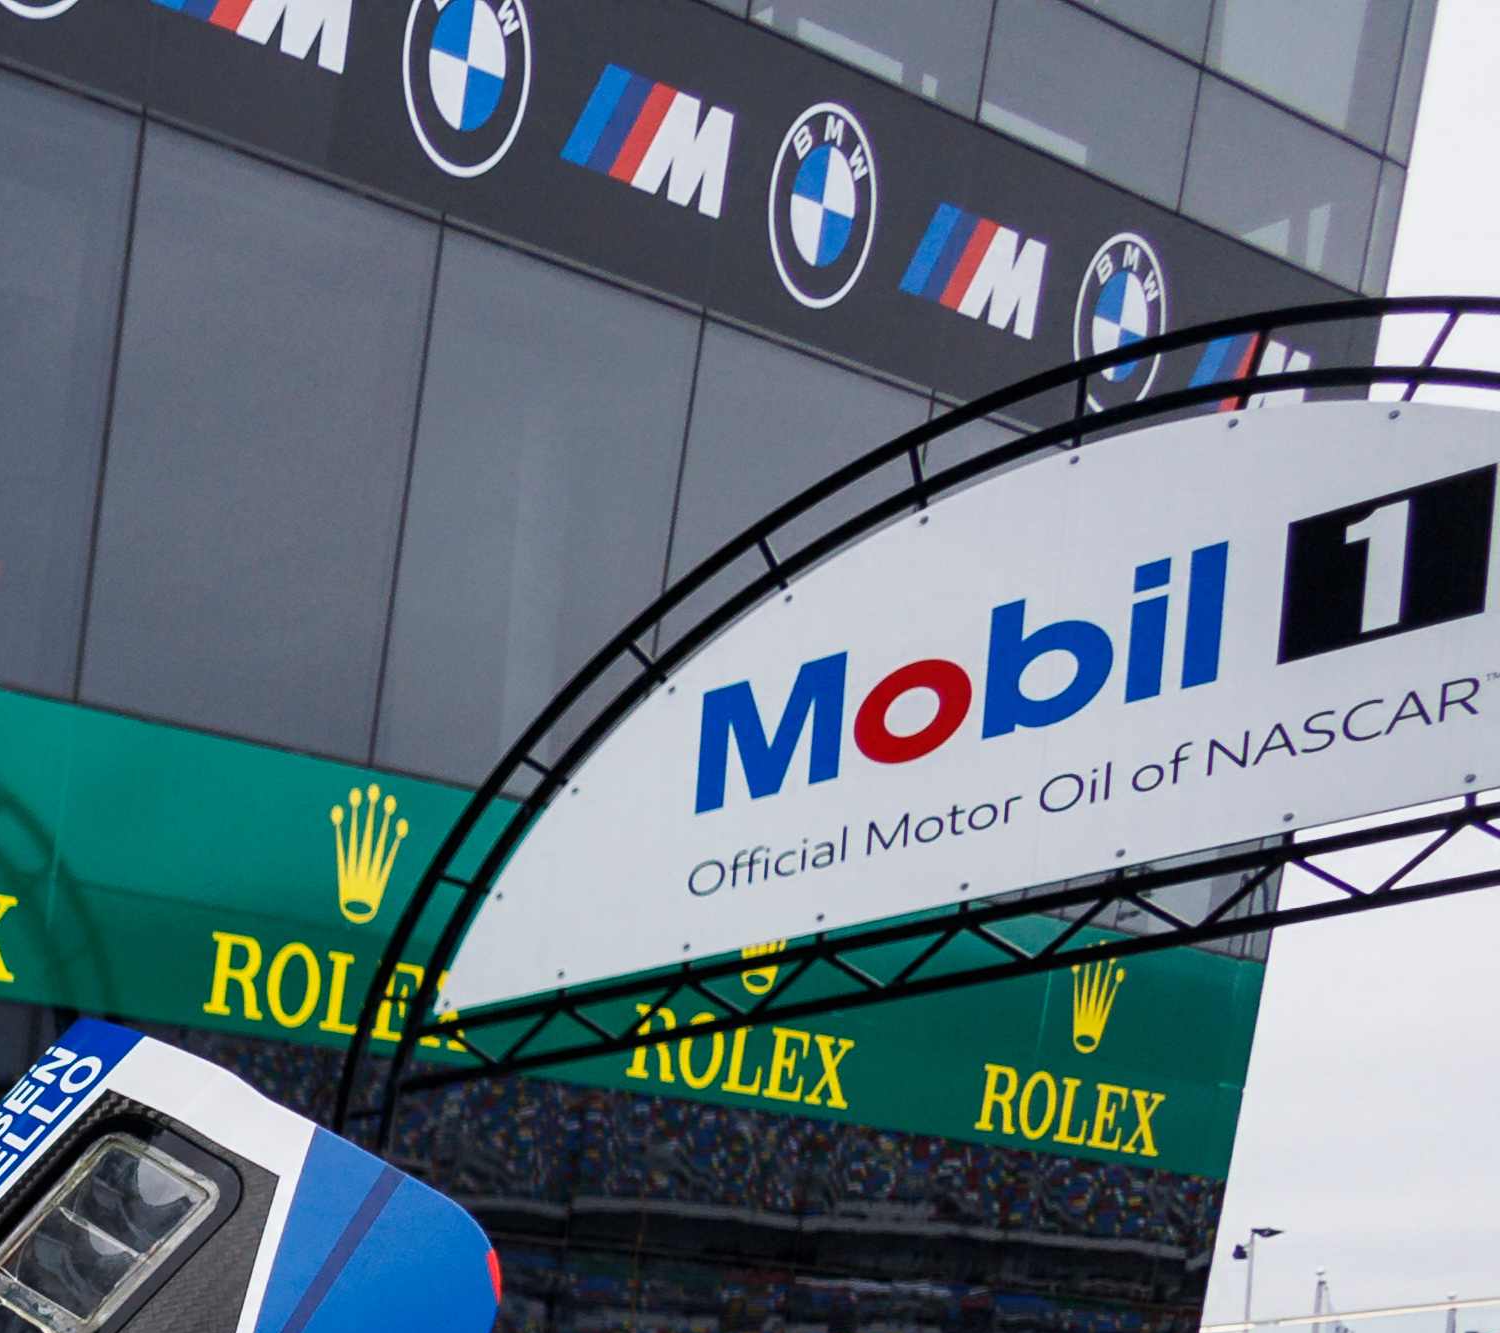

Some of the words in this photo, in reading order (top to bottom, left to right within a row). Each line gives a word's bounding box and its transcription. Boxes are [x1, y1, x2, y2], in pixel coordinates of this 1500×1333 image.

[695, 541, 1230, 815] Mobil
[688, 826, 849, 897] Official
[866, 796, 1023, 856] Motor
[1039, 762, 1111, 813] Oil
[1131, 742, 1194, 792] of
[1206, 677, 1480, 777] NASCAR
[626, 1003, 856, 1110] ROLEX
[975, 1064, 1165, 1158] ROLEX
